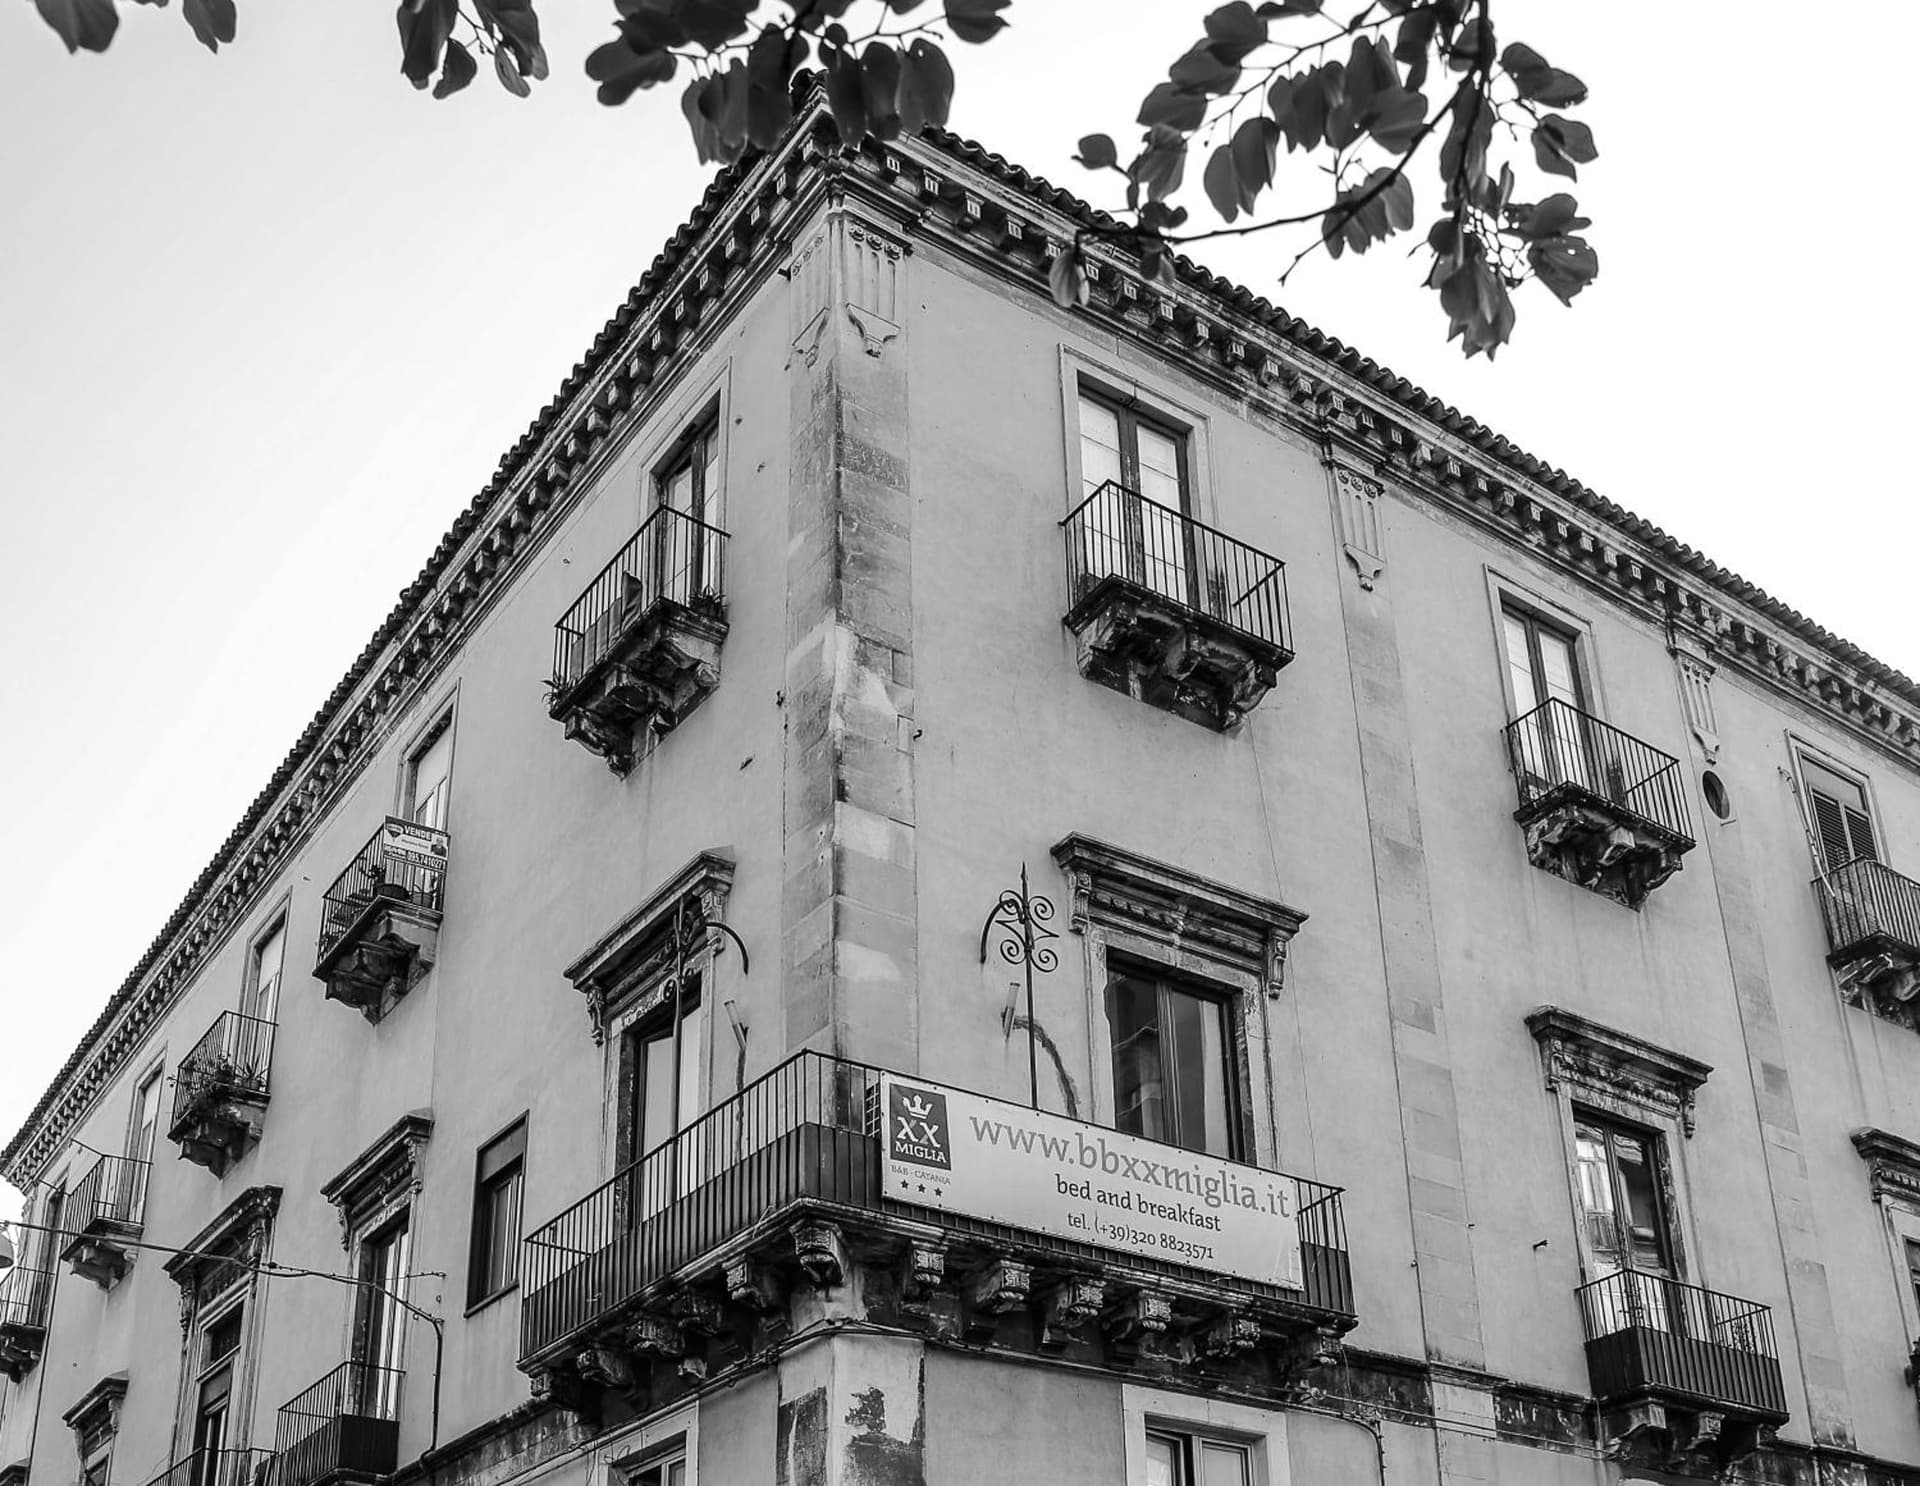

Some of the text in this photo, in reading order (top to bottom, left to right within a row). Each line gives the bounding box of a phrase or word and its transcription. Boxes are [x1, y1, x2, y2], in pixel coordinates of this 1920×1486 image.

[403, 825, 431, 840] VENDE
[897, 1116, 940, 1148] XX
[895, 1141, 947, 1163] MIGLIA
[969, 1115, 1289, 1218] www.bbxxmiglia.it
[891, 1164, 908, 1176] B&B
[915, 1170, 951, 1186] CATANIA
[1055, 1173, 1221, 1231] bed and breakfast
[1068, 1210, 1214, 1260] tel. (+39)320 8823571
